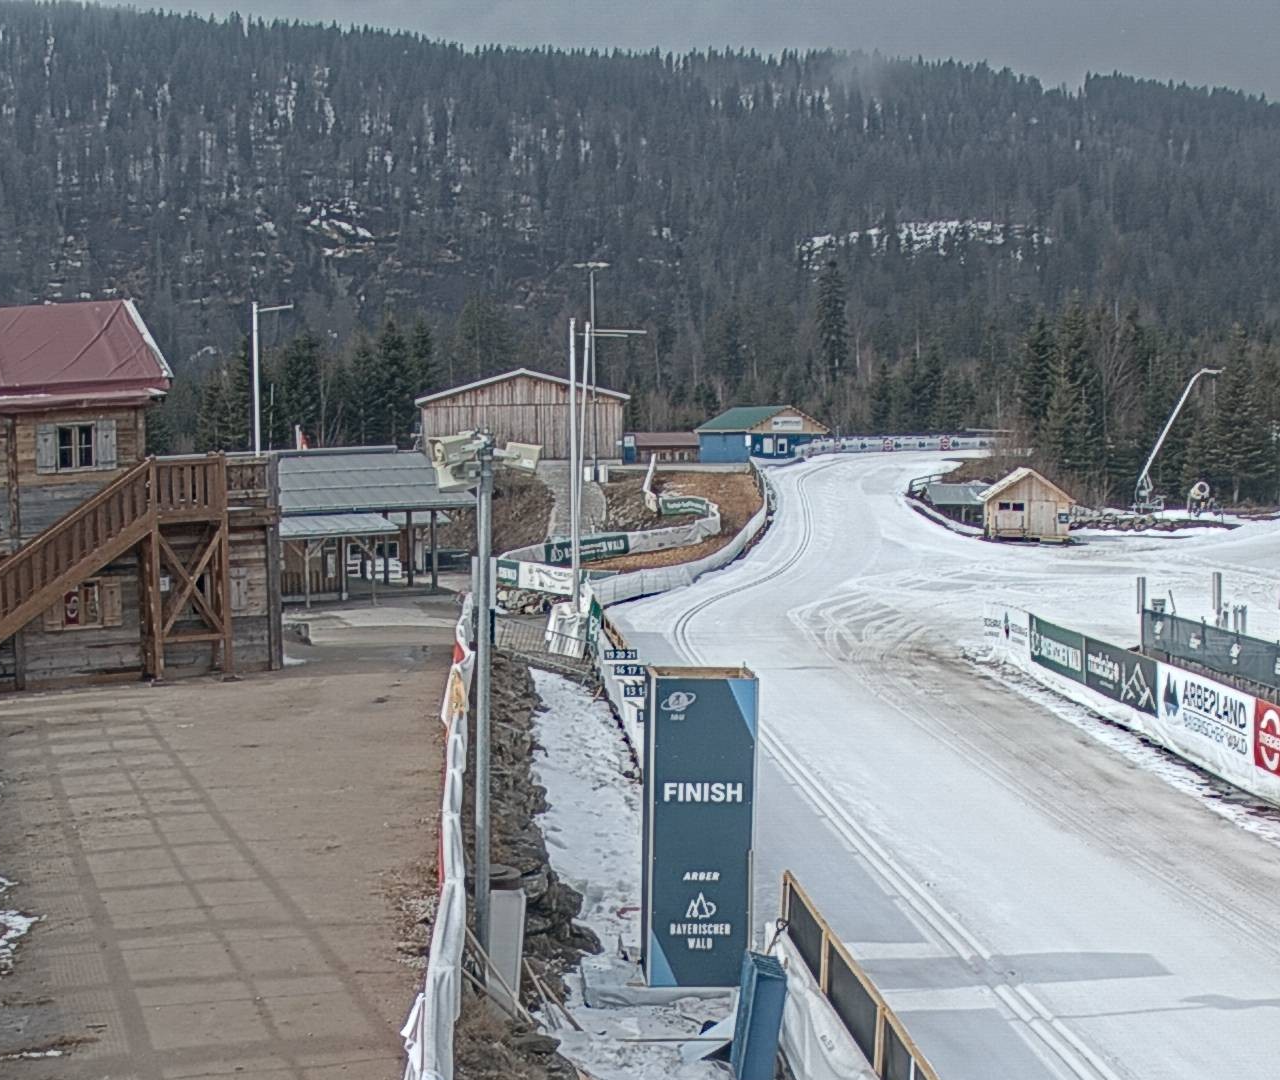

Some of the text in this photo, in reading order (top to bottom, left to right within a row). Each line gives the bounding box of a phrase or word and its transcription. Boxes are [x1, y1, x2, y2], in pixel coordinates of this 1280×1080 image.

[606, 651, 636, 659] 19 20 21
[616, 666, 625, 674] 16
[627, 666, 637, 674] 17
[625, 686, 636, 696] 13
[1182, 680, 1247, 729] ARBERLAND
[1227, 733, 1248, 756] WALD
[663, 782, 743, 803] FINISH
[683, 871, 720, 881] ARBER
[669, 923, 731, 936] BAYERISCHER
[687, 937, 713, 950] WALD
